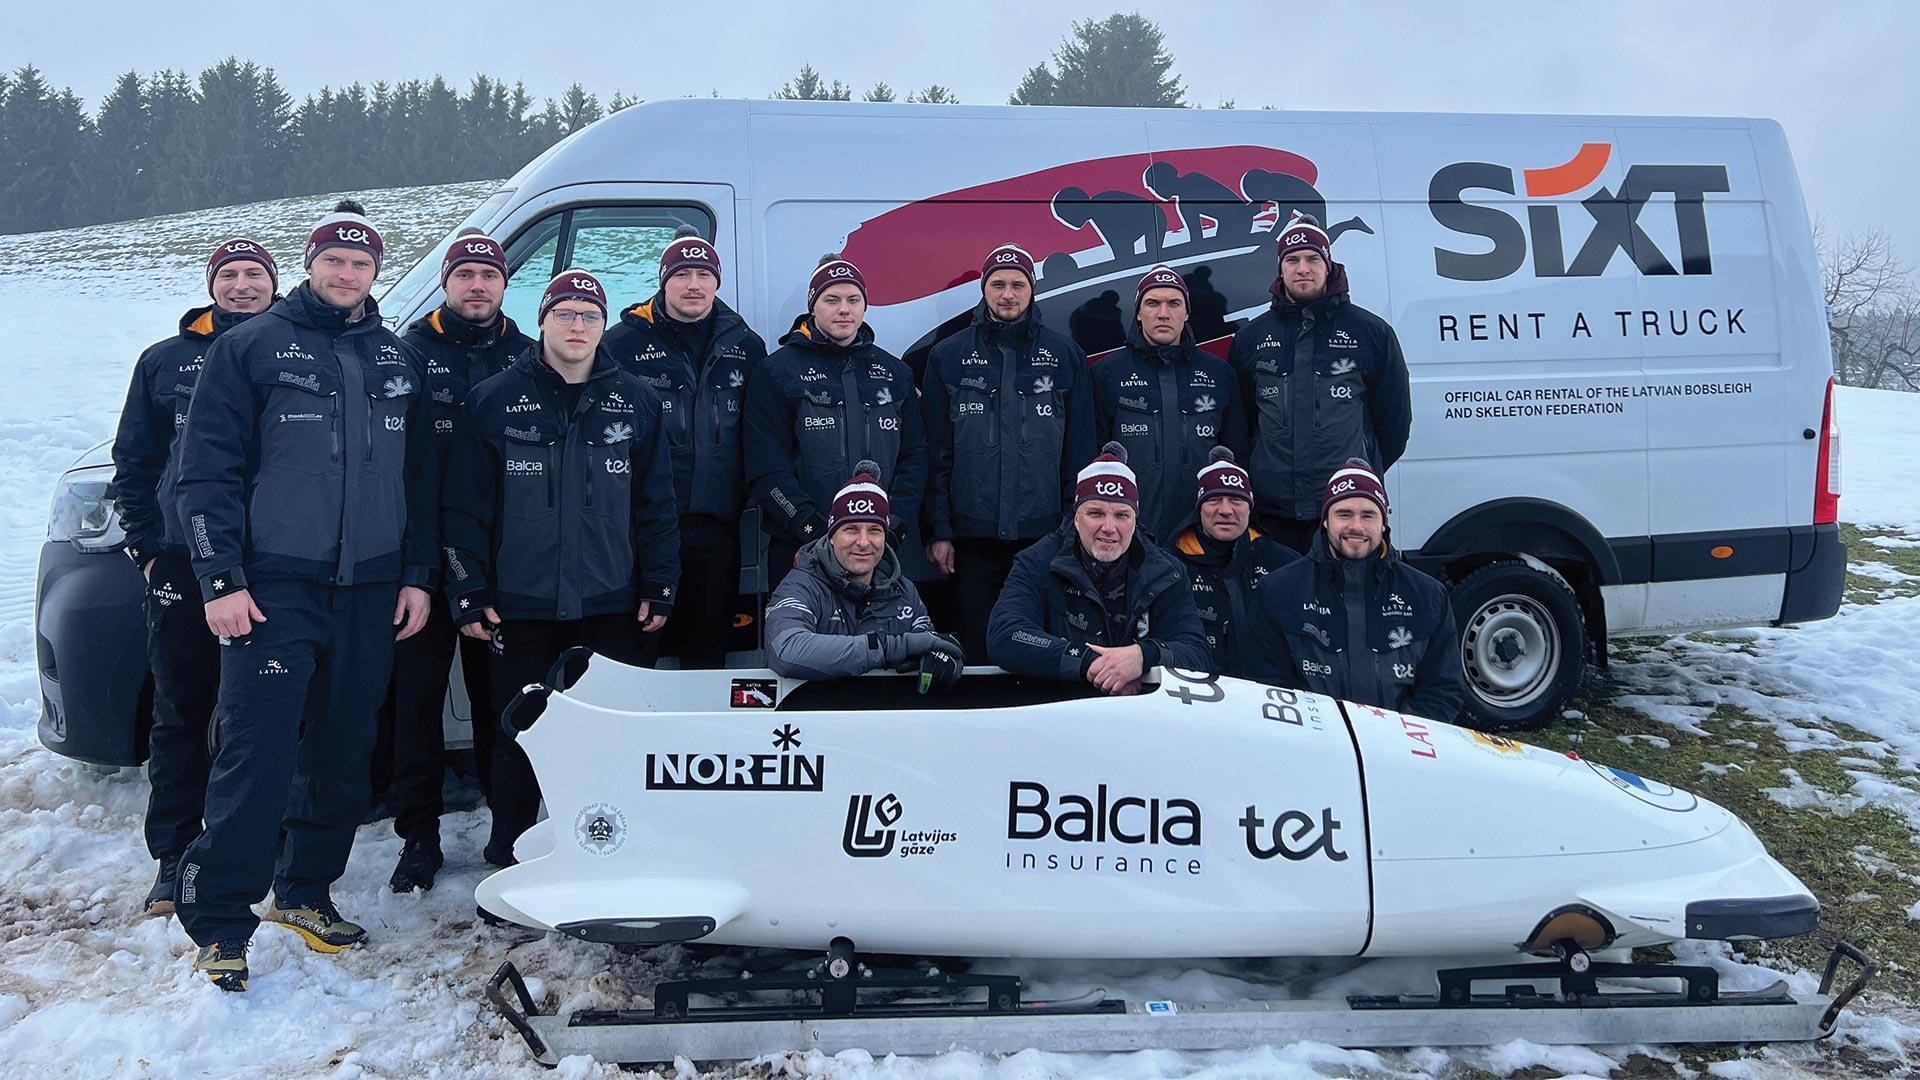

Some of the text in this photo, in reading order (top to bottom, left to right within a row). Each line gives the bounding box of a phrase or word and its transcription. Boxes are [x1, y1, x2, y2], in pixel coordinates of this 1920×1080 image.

[336, 227, 370, 246] tet
[1284, 232, 1308, 246] tet
[224, 241, 258, 254] tet
[464, 241, 495, 256] tet
[680, 246, 709, 260] tet
[995, 253, 1019, 264] tet
[827, 266, 854, 279] tet
[1154, 273, 1178, 285] tet
[570, 276, 599, 296] tet
[1438, 308, 1748, 342] RENT A TRUCK
[1257, 341, 1281, 350] LATVIJA
[276, 351, 315, 361] LATVIJA
[635, 350, 667, 362] LATVIJA
[179, 363, 204, 372] LATV
[427, 366, 451, 374] TVIJA
[800, 373, 827, 382] LATVIJA
[1330, 385, 1352, 399] tet
[1444, 382, 1753, 403] OFFICIAL CAR RENTAL OF THE LATVIAN BOBSLEIGH
[506, 403, 542, 413] LATVIJA
[601, 401, 635, 409] LATVIA
[1444, 402, 1624, 420] AND SKELETON FEDERATION
[804, 416, 835, 427] Balcia
[878, 416, 899, 431] tet
[1120, 423, 1149, 433] Balcia
[1195, 424, 1215, 437] tet
[506, 459, 543, 471] Balcia
[605, 458, 630, 474] tet
[1219, 472, 1245, 489] tet
[1330, 478, 1356, 496] tet
[1095, 481, 1124, 497] tet
[846, 499, 876, 514] tet
[153, 588, 182, 601] LATVIJA
[649, 753, 821, 791] NORFIN
[1007, 780, 1202, 846] Balcia
[900, 829, 958, 845] Latvijas
[1239, 804, 1349, 862] tet
[900, 842, 936, 858] gāze
[1006, 852, 1202, 875] insurance
